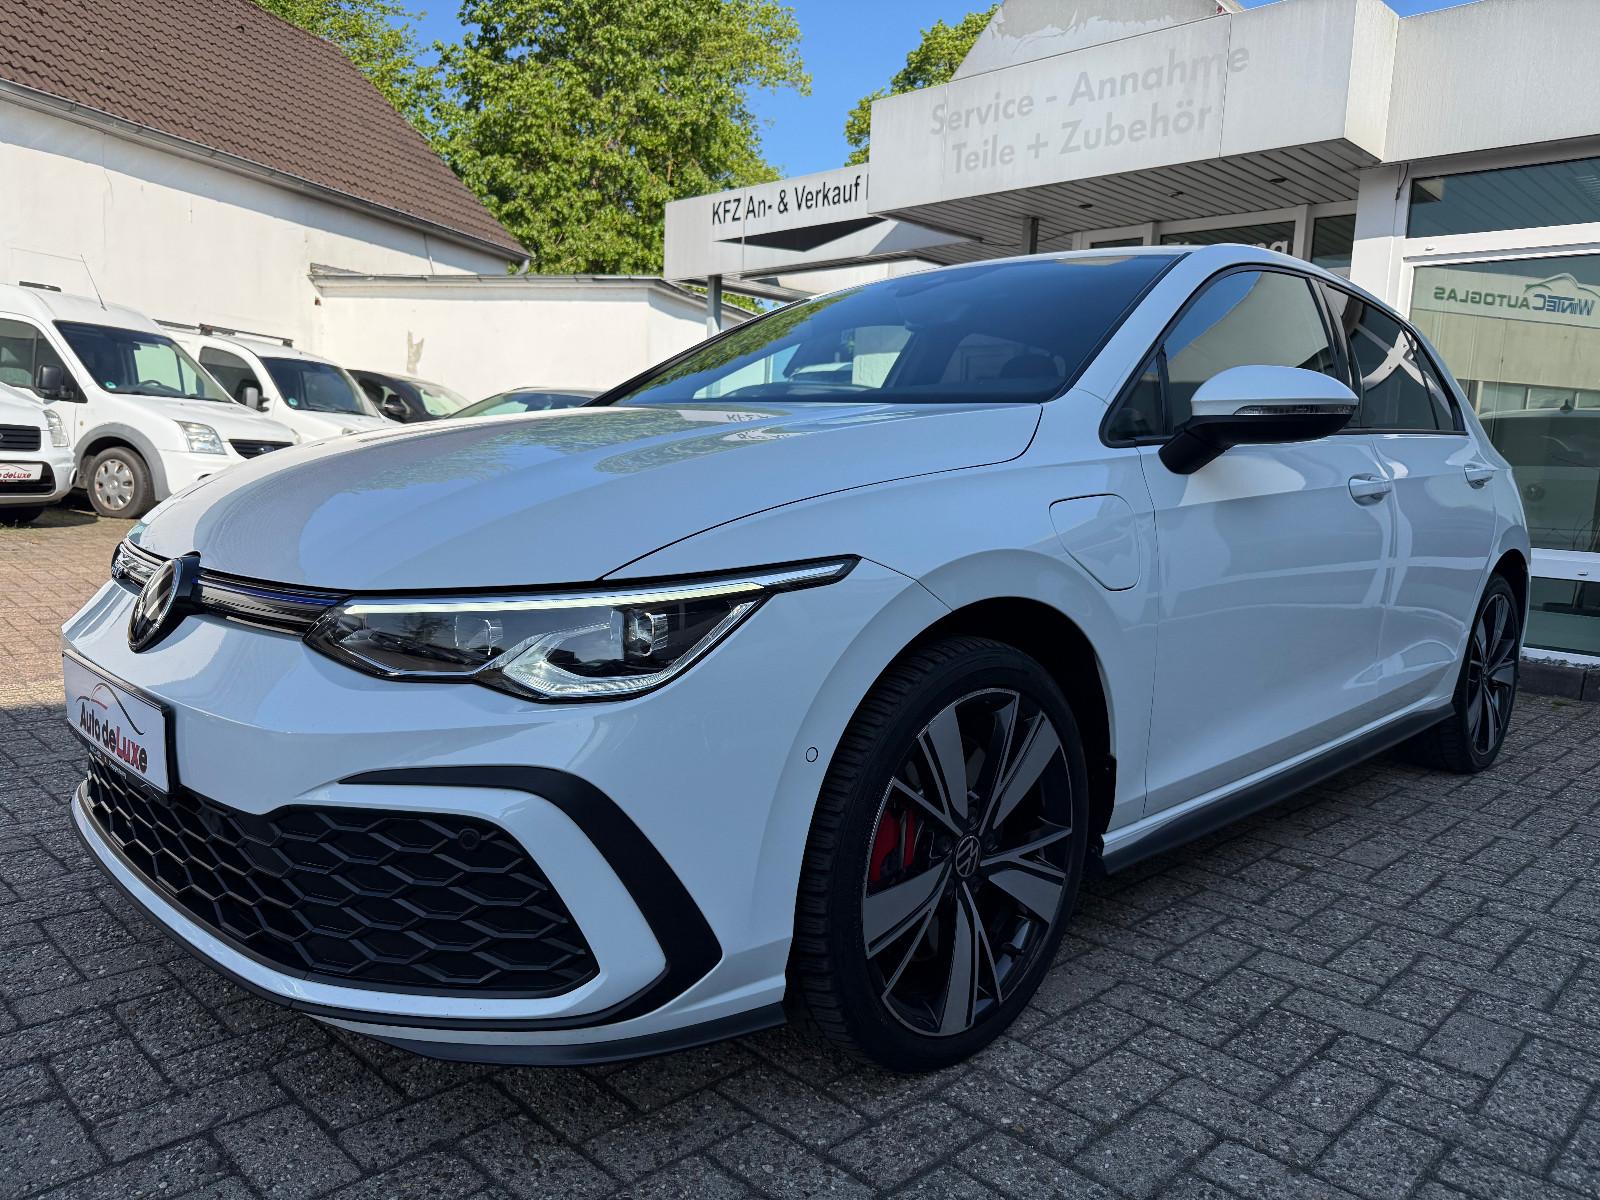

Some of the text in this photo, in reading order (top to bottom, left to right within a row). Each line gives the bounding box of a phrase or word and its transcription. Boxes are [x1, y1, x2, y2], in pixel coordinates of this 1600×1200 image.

[930, 91, 1035, 135] Service
[1068, 47, 1250, 106] Annahme
[952, 99, 1212, 173] Teile + Zubehör
[712, 197, 742, 225] KFZ
[777, 189, 789, 214] &
[795, 175, 861, 211] Verkauf
[80, 701, 100, 742] Auto
[101, 719, 148, 775] deLuxe
